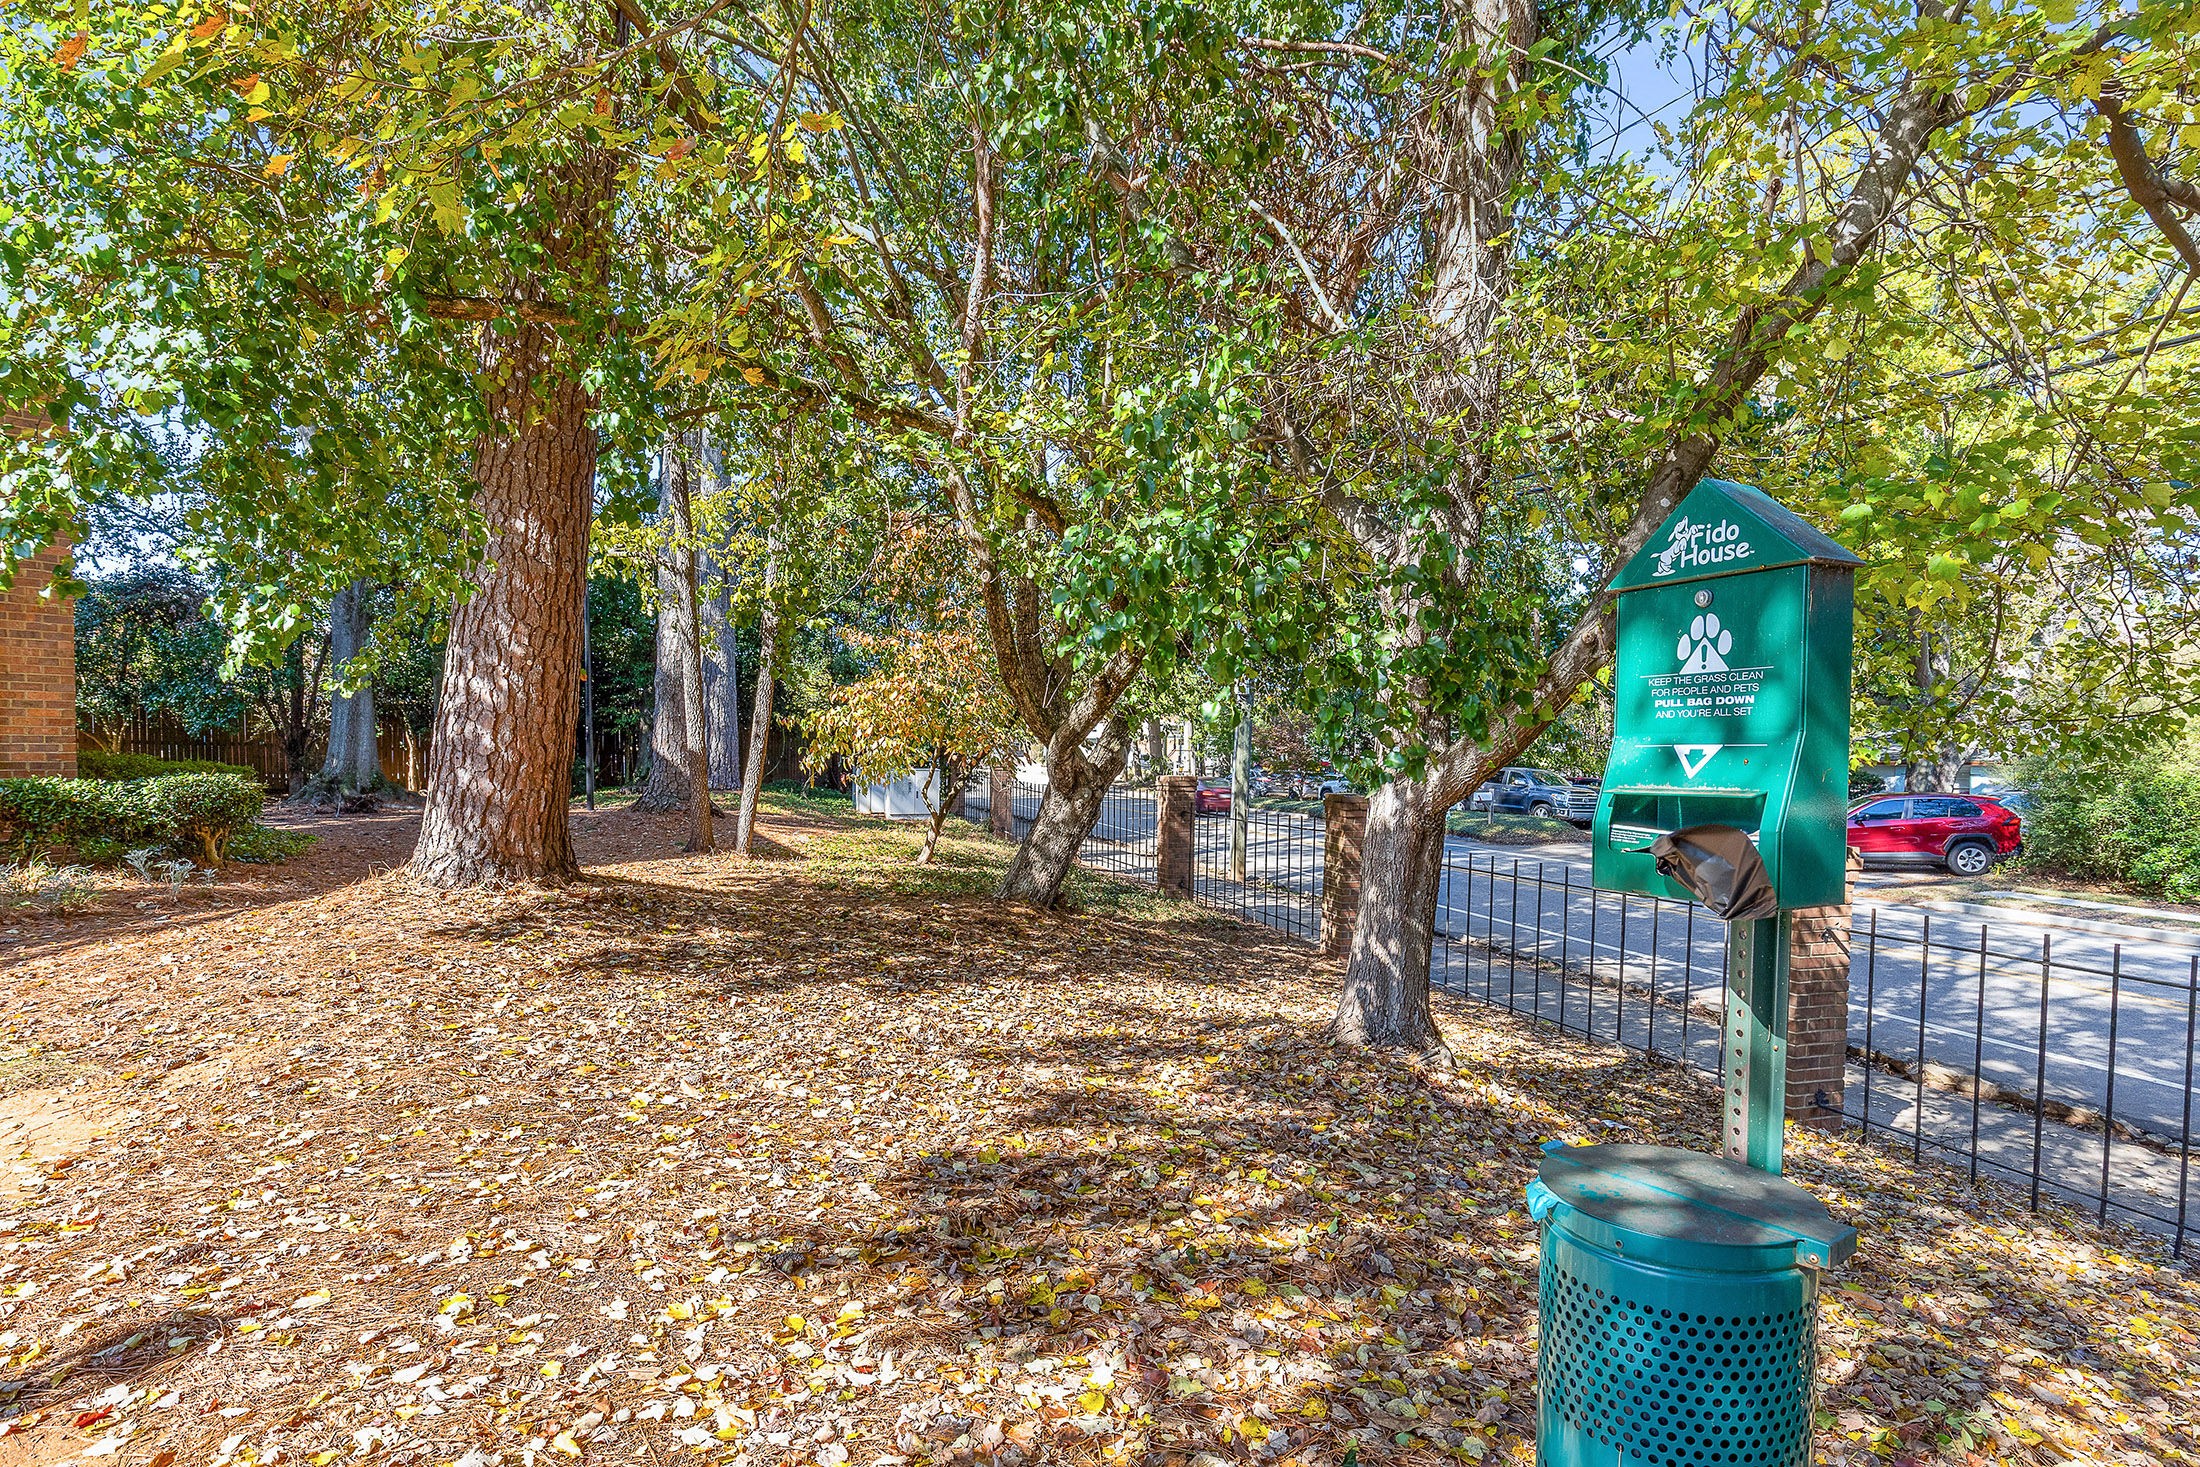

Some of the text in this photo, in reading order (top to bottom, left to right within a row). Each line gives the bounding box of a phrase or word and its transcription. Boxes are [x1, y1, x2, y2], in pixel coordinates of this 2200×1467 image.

[1690, 519, 1740, 548] Fido
[1680, 542, 1750, 568] House
[1648, 671, 1764, 687] KEEP THE GRASS CLEAN
[1651, 683, 1760, 697] FOR PEOPLE AND PETS
[1655, 695, 1755, 708] PULL BAG DOWN
[1655, 706, 1753, 719] AND YOU'RE ALL SET
